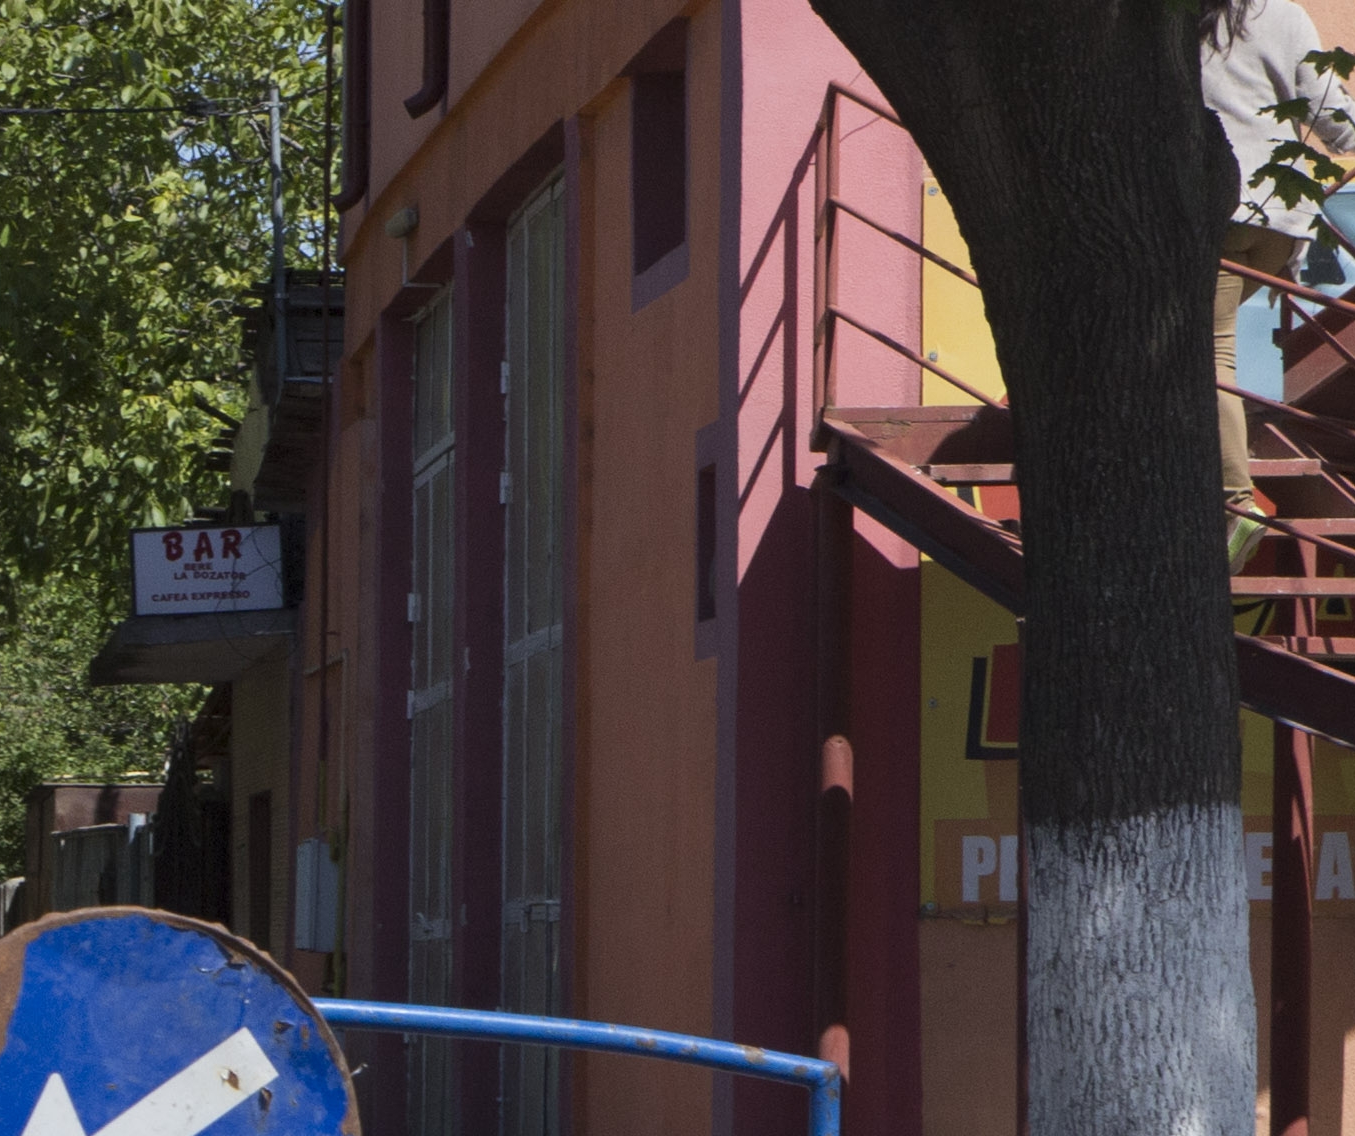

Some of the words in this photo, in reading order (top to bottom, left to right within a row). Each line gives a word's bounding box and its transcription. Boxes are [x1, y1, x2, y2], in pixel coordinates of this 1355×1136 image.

[162, 529, 242, 562] BAR
[173, 572, 188, 580] LA
[193, 571, 246, 580] DOZATOR
[151, 593, 188, 602] CAFEA
[191, 590, 250, 600] EXPRESSO
